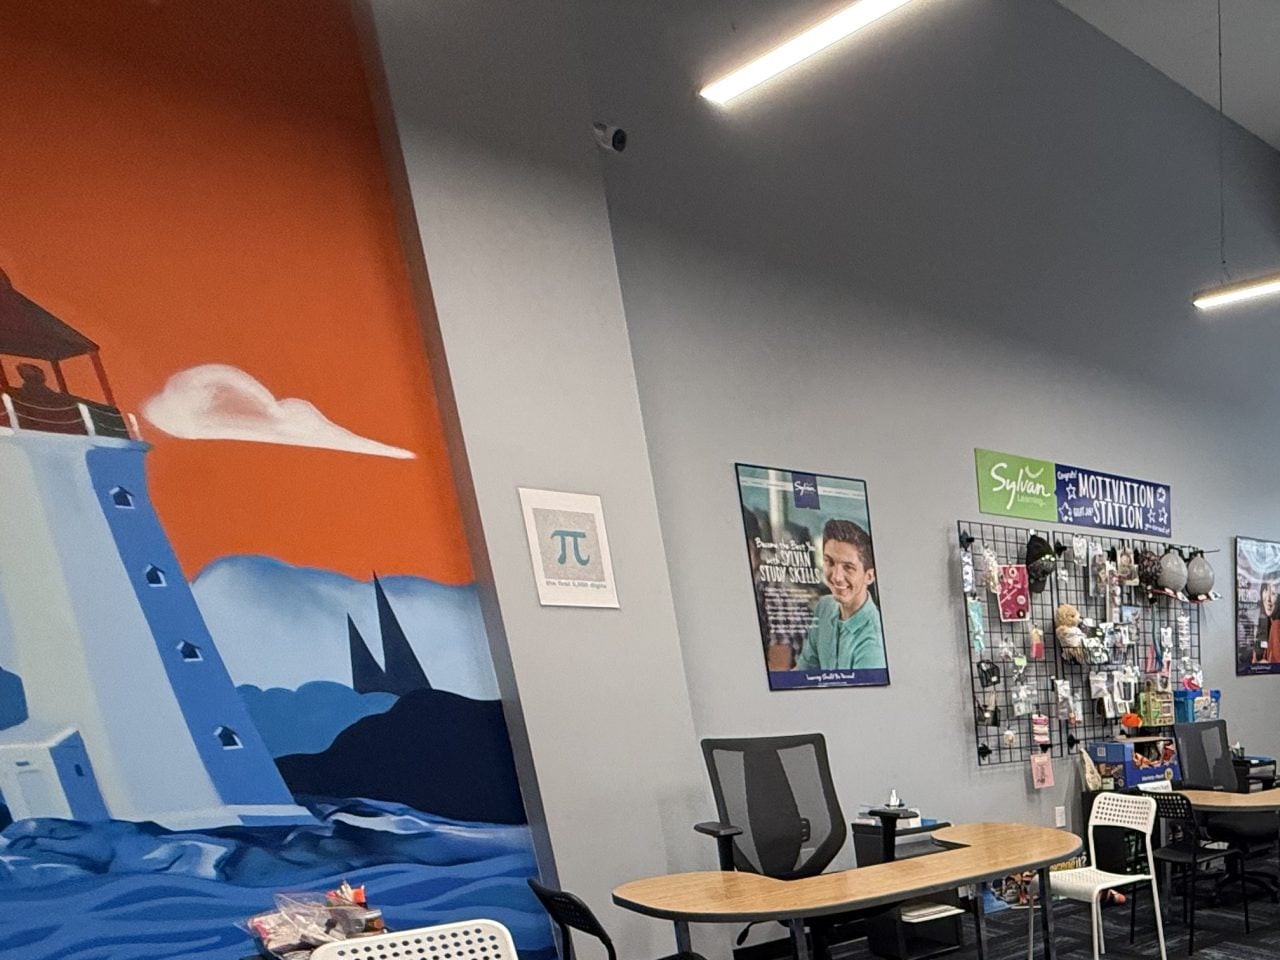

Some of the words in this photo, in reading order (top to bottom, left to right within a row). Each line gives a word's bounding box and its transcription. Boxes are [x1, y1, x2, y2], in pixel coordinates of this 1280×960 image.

[794, 481, 816, 496] Sylvan
[990, 462, 1051, 510] Sylvan
[1078, 472, 1155, 509] MOTIVATION
[1093, 499, 1144, 530] STATION
[780, 550, 811, 567] SYLVAN
[760, 564, 787, 582] STUDY
[788, 566, 820, 584] SKILLS
